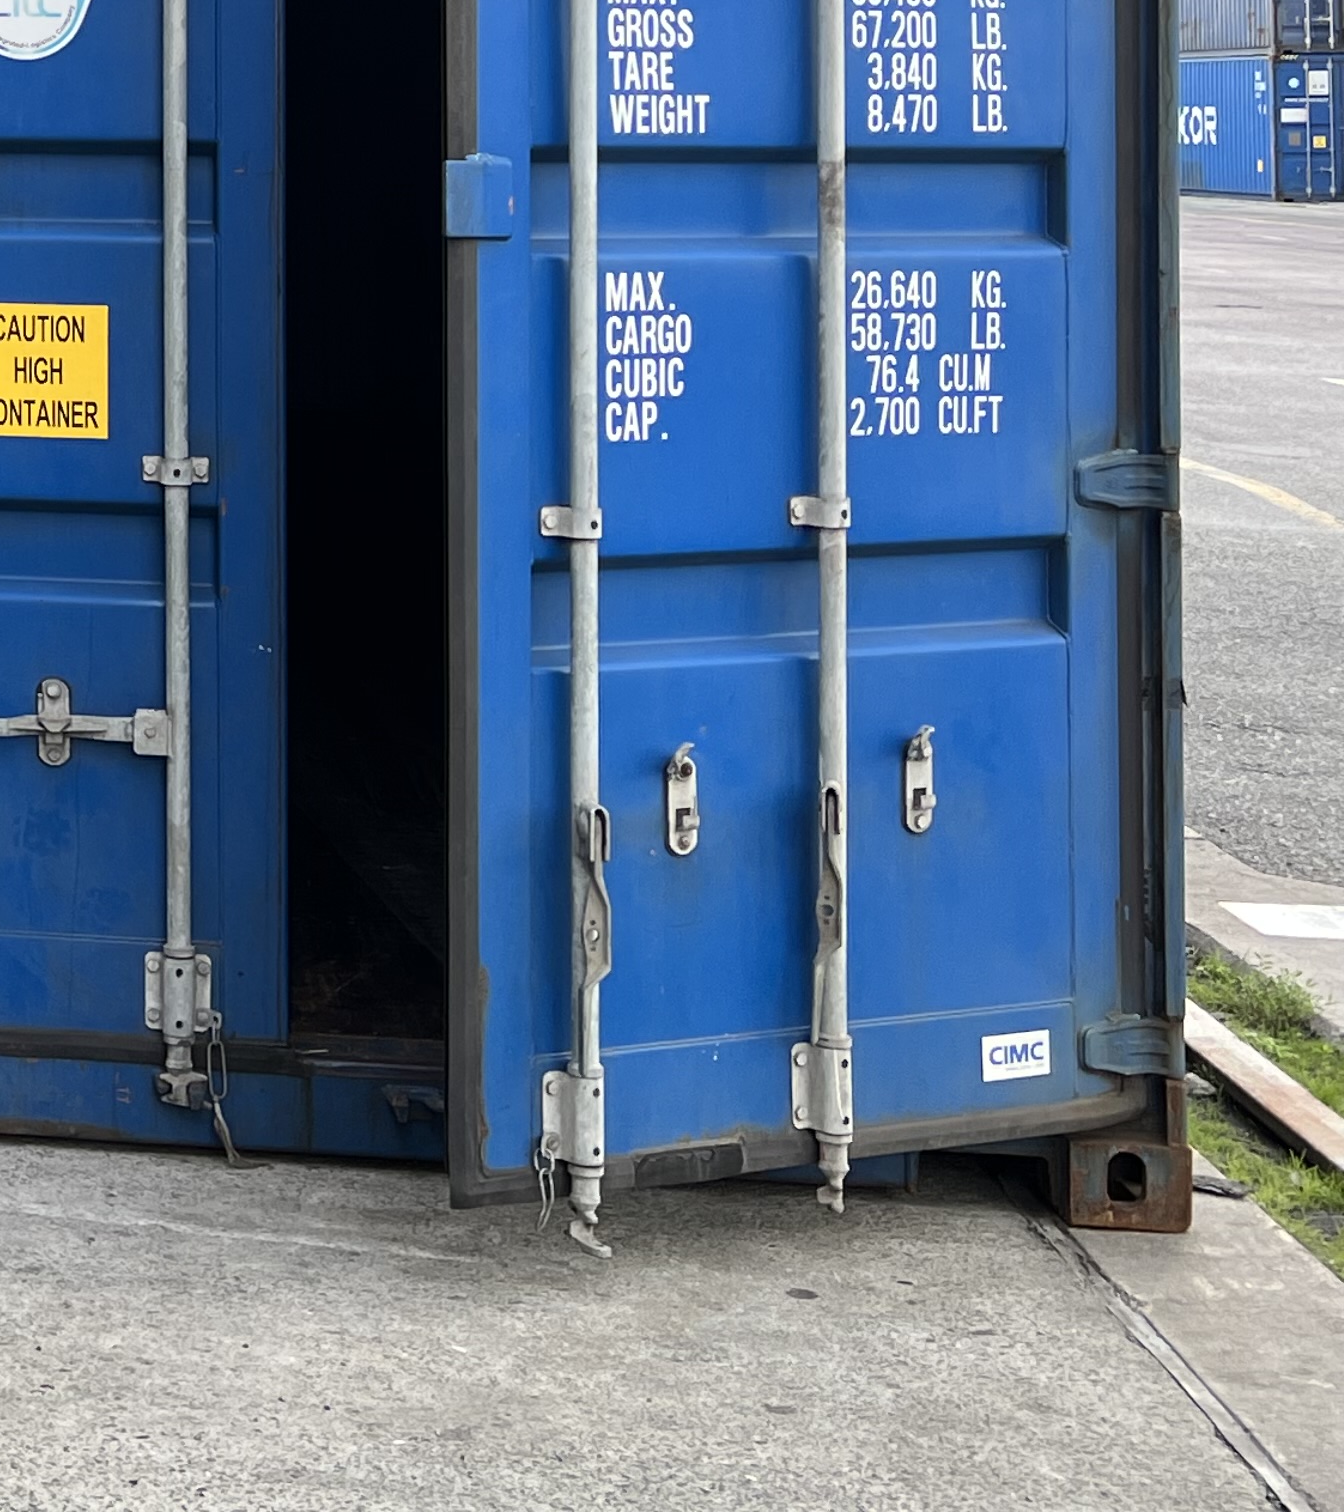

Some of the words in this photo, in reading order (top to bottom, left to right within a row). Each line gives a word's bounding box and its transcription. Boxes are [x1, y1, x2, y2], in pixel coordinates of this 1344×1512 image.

[608, 8, 694, 50] GROSS
[851, 10, 937, 51] 67,200
[970, 10, 1007, 51] LB.
[609, 50, 674, 91] TARE
[867, 52, 937, 92] 3,840
[971, 52, 1008, 92] KG.
[609, 94, 711, 135] WEIGHT
[867, 94, 938, 134] 8,470
[971, 94, 1009, 134] LB.
[605, 270, 677, 313] MAX.
[850, 270, 937, 311] 26,640
[970, 270, 1007, 311] KG.
[605, 314, 692, 356] CARGO
[850, 311, 937, 353] 58,730
[970, 311, 1006, 353] LB.
[14, 356, 63, 385] HIGH
[605, 356, 686, 398] CUBIC
[866, 353, 920, 395] 76.4
[938, 353, 991, 395] CU.M
[605, 400, 669, 443] CAP.
[850, 394, 920, 437] 2,700
[937, 394, 1003, 437] CU.FT
[989, 1042, 1044, 1065] CIMC
